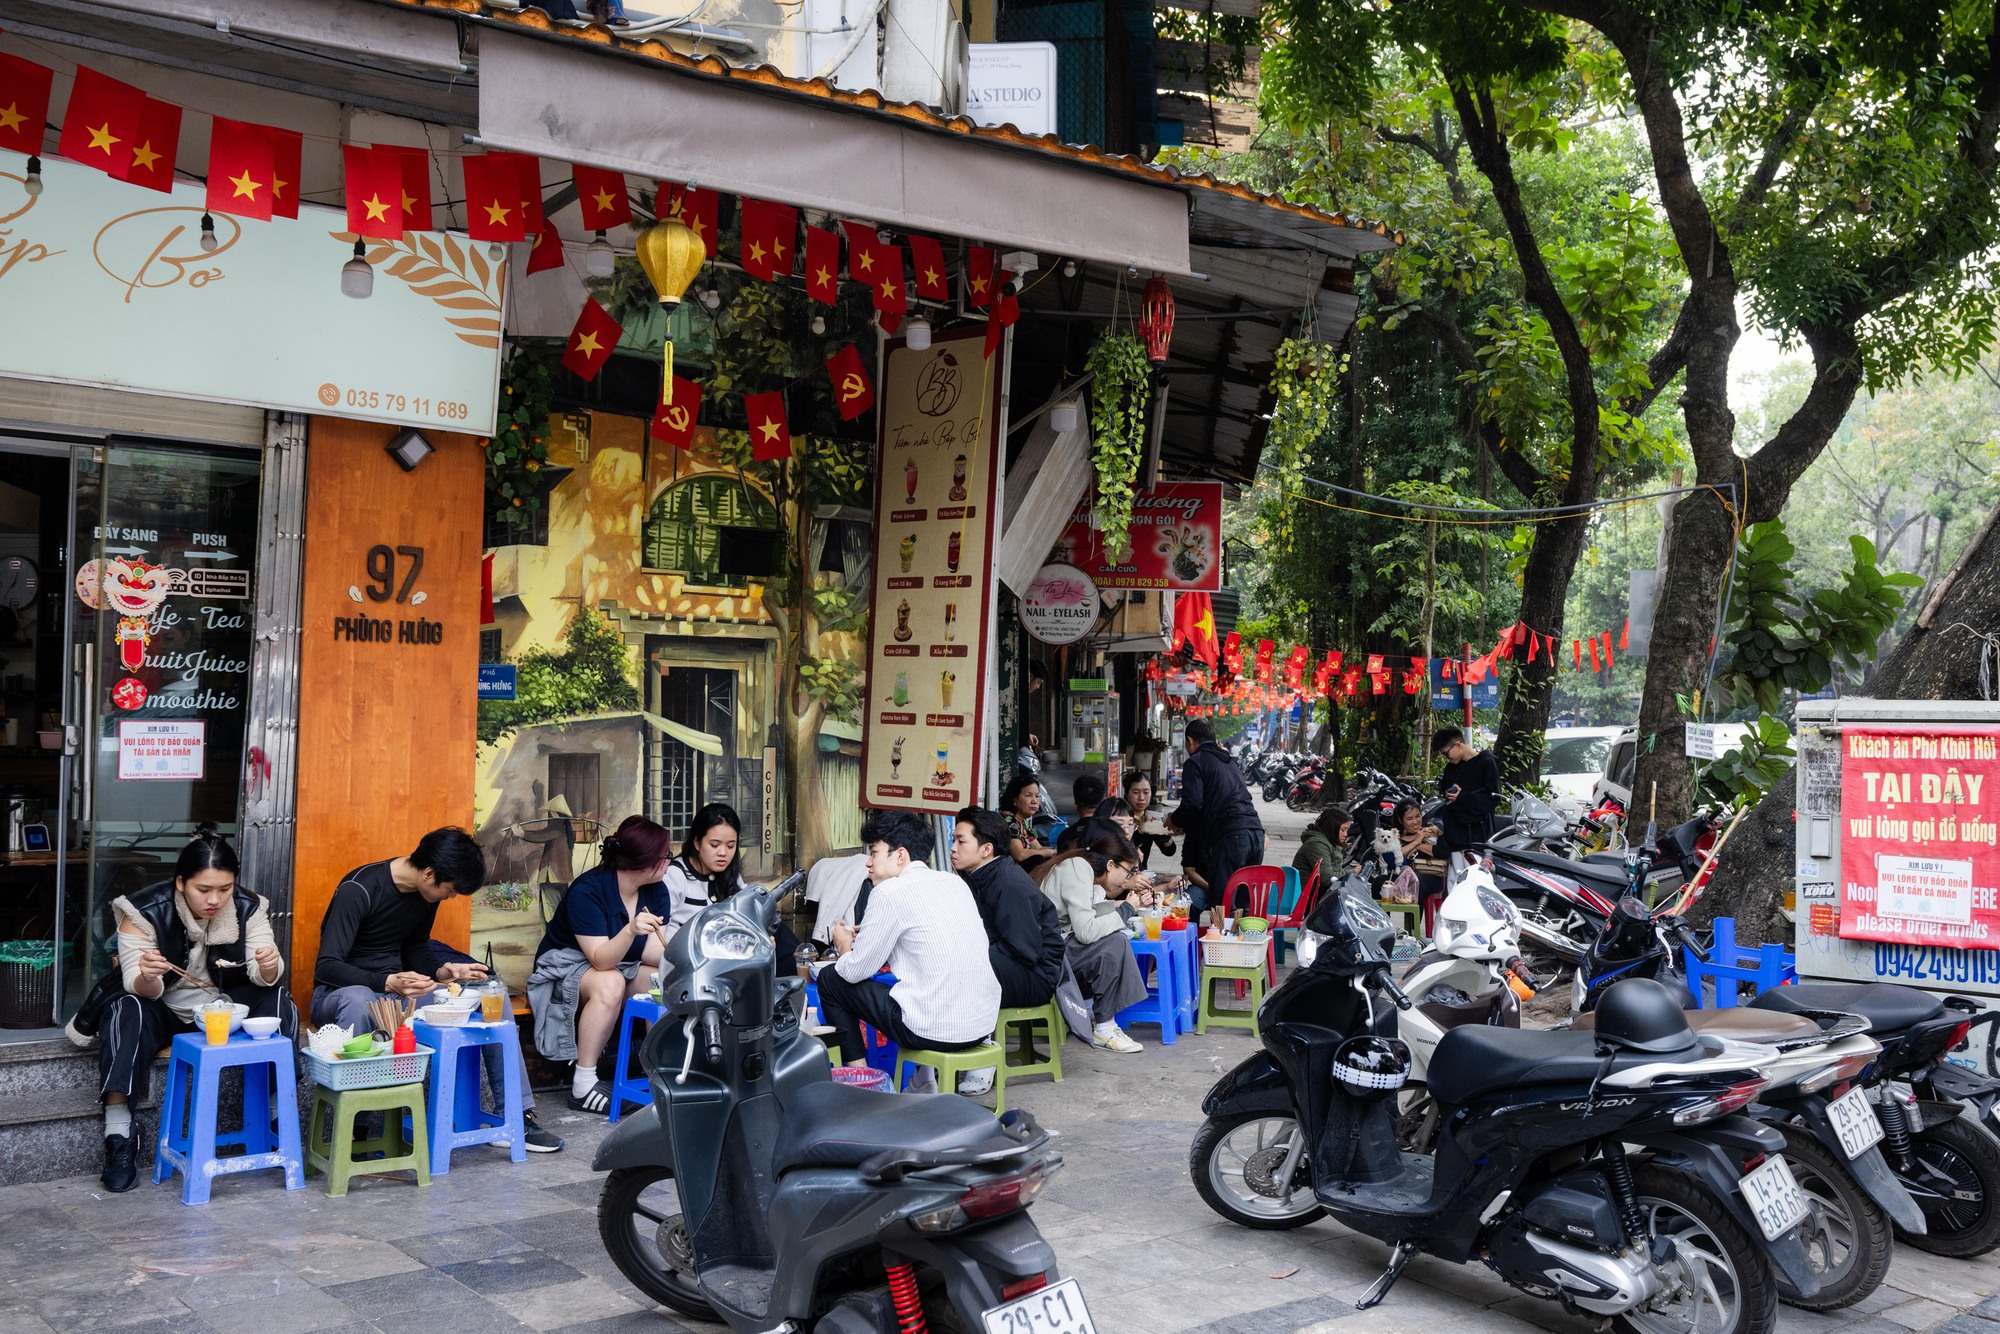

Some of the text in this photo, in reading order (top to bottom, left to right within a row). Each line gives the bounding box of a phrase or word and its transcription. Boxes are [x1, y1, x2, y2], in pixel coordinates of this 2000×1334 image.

[984, 87, 1041, 102] STUDIO
[94, 207, 241, 303] Bơ
[347, 389, 468, 420] 035 79 11 689
[1131, 487, 1204, 521] ương
[1129, 514, 1175, 527] RỌN GÓI
[94, 521, 227, 547] ĐẨY SANG PUSH
[366, 544, 424, 603] 97
[1117, 564, 1137, 573] CƯỚI
[1115, 578, 1135, 587] 0979
[1137, 578, 1152, 587] 829
[1154, 578, 1169, 587] 358
[145, 604, 181, 635] afe
[200, 606, 246, 629] Tea
[1026, 608, 1046, 617] NAIL
[1054, 608, 1091, 618] EYELASH
[335, 612, 442, 645] PHÙNG HƯNG
[482, 668, 495, 676] PHỐ
[478, 679, 512, 691] ÙNG HƯNG
[145, 688, 240, 709] moothie
[124, 735, 201, 747] VUI LÒNG TỰ BẢO QUẢN
[134, 747, 144, 756] TÀI
[146, 746, 160, 756] SẢN
[173, 747, 191, 756] NHÂN
[1849, 734, 1997, 760] Khách ăn Phở Khôi Hói
[1863, 772, 1911, 809] TẠI
[1920, 767, 1984, 805] ĐÂY
[1850, 814, 1997, 846] vui lòng gọi đồ uống
[1908, 861, 1920, 869] XIN
[1921, 862, 1933, 870] LƯU
[1882, 873, 1968, 888] VUI LÒNG TỰ BẢO QUẢN
[1893, 884, 1904, 894] TÀI
[1907, 885, 1922, 896] SẢN
[1937, 888, 1957, 899] NHÂN
[1971, 886, 1997, 910] ERE
[1856, 913, 1902, 932] please
[1416, 1037, 1437, 1046] HONDA
[1833, 1092, 1866, 1129] 29-S1
[1841, 1114, 1881, 1154] 677.72
[1750, 1163, 1788, 1203] 14-Z1
[1001, 1289, 1073, 1334] 29-C1
